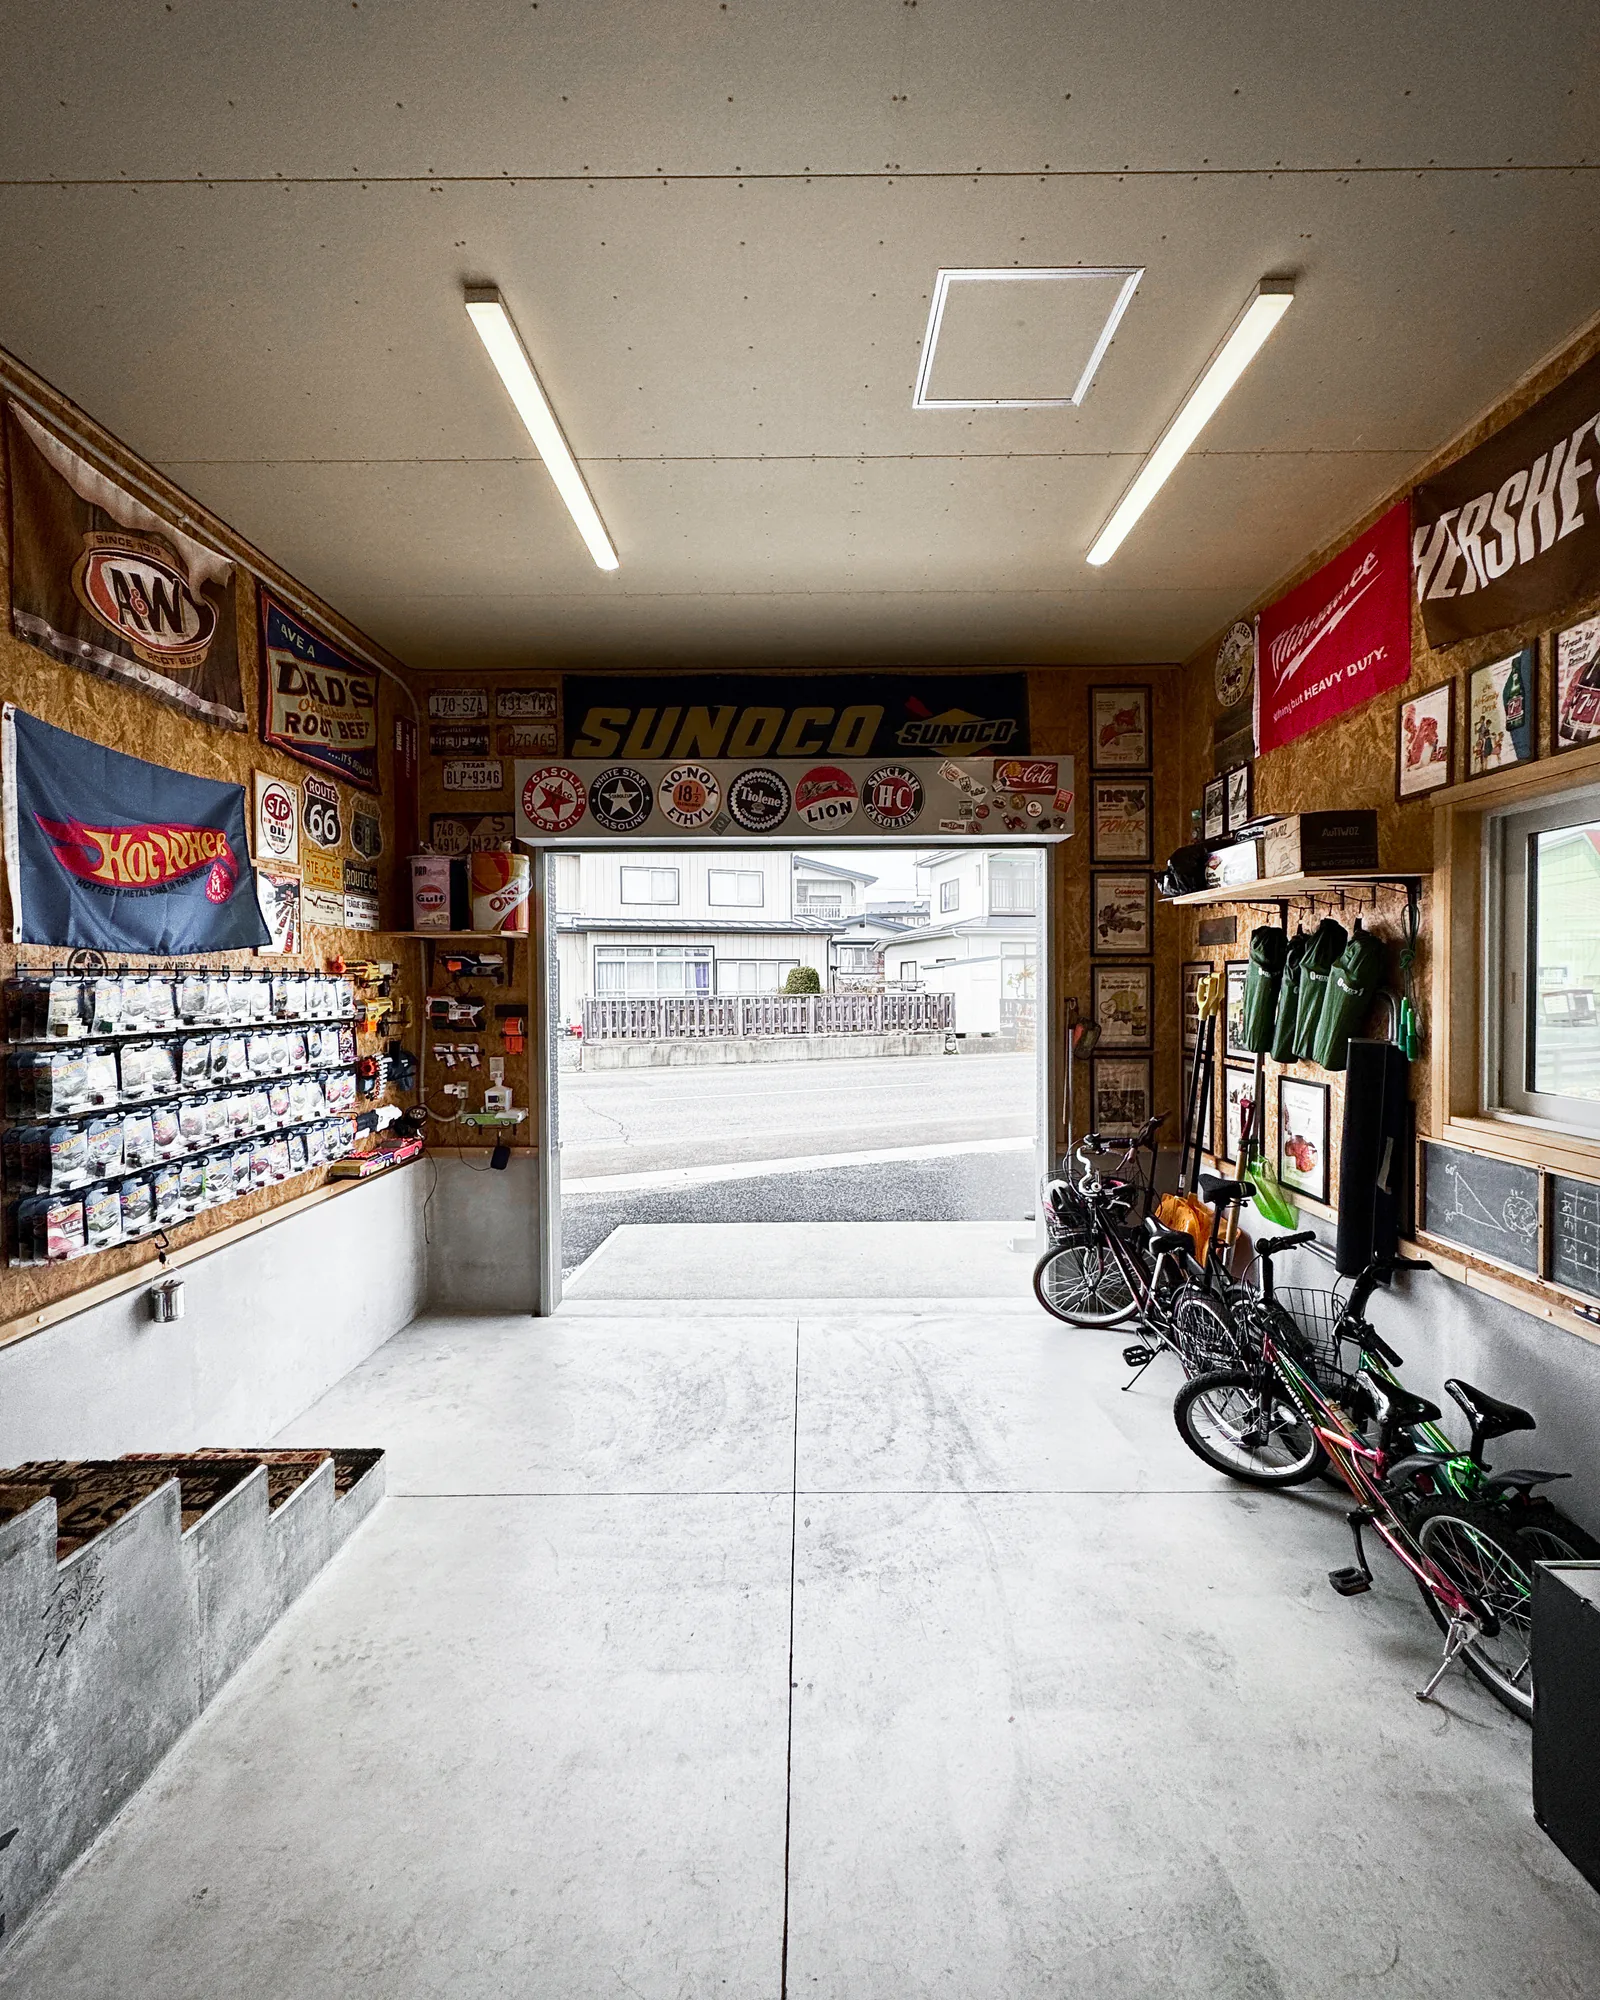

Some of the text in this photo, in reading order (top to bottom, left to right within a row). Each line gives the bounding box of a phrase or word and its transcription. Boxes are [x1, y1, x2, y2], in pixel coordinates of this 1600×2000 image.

[1412, 411, 1600, 604] HERSHE
[95, 534, 134, 548] SINCE
[109, 566, 190, 637] A&W
[276, 660, 374, 709] DAD'S
[1304, 668, 1344, 702] HEAVY
[1346, 645, 1389, 678] DUTY.
[571, 705, 885, 759] SUNOCO
[900, 719, 1015, 745] SUNOCO
[531, 767, 586, 805] GASOLINE
[592, 768, 648, 790] WHITE STAR
[661, 766, 719, 796] NO-NOX
[867, 766, 921, 793] SINCLAIR
[309, 780, 337, 802] ROUTE
[740, 785, 782, 808] Tiolene
[1099, 789, 1145, 803] new
[267, 795, 289, 817] STP
[523, 790, 581, 831] MOTOR OIL
[666, 807, 714, 825] ETHYL
[806, 800, 854, 823] LION
[864, 803, 919, 828] GASOLINE
[270, 824, 287, 837] OIL
[309, 803, 337, 841] 66
[437, 823, 454, 837] 748
[595, 811, 648, 831] GASOLINE
[305, 859, 319, 875] RTE
[331, 865, 341, 880] 66
[345, 868, 379, 891] ROUTE 66
[75, 878, 124, 898] HOTTEST
[122, 889, 149, 898] METAL
[150, 884, 167, 896] CARS
[168, 882, 175, 893] IN
[175, 877, 190, 890] THE
[416, 894, 447, 903] Gulf
